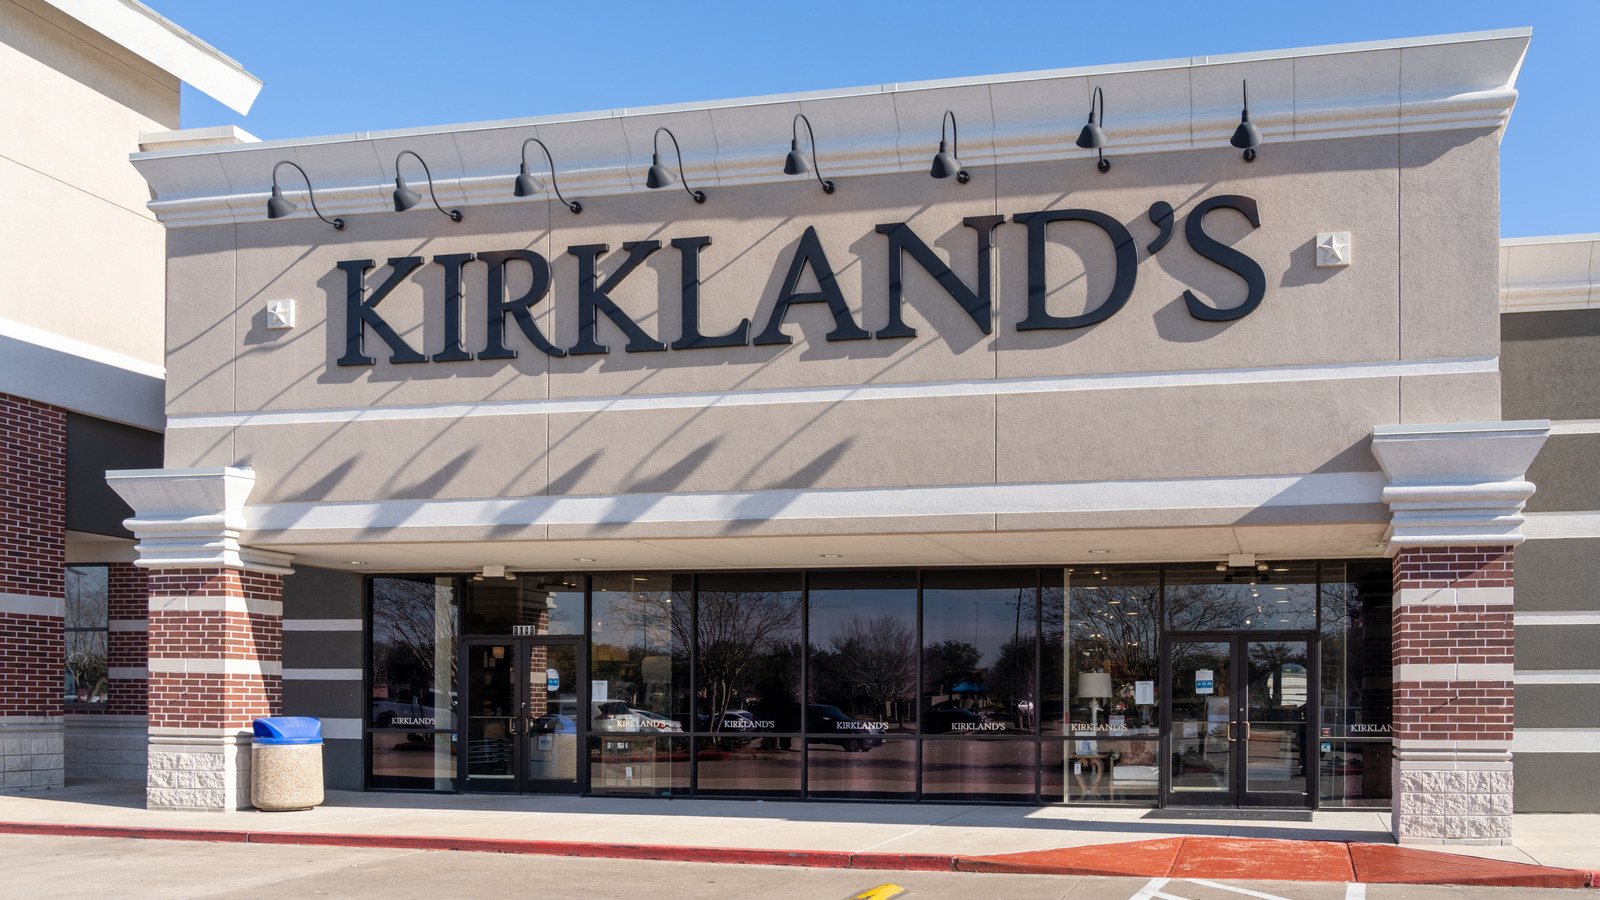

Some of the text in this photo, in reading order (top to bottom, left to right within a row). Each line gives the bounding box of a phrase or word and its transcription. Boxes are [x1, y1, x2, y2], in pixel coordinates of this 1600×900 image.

[336, 194, 1266, 366] KIRKLAND'S
[391, 717, 437, 725] KIRKLAND'S
[616, 719, 666, 728] KIRKLAND'S
[724, 720, 775, 728] KIRKLAND'S
[836, 721, 889, 730] KIRKLAND'S
[951, 722, 1006, 731] KIRKLAND'S
[1071, 723, 1128, 732] KIRKLAND'S
[1350, 723, 1393, 733] KIRKLAN
